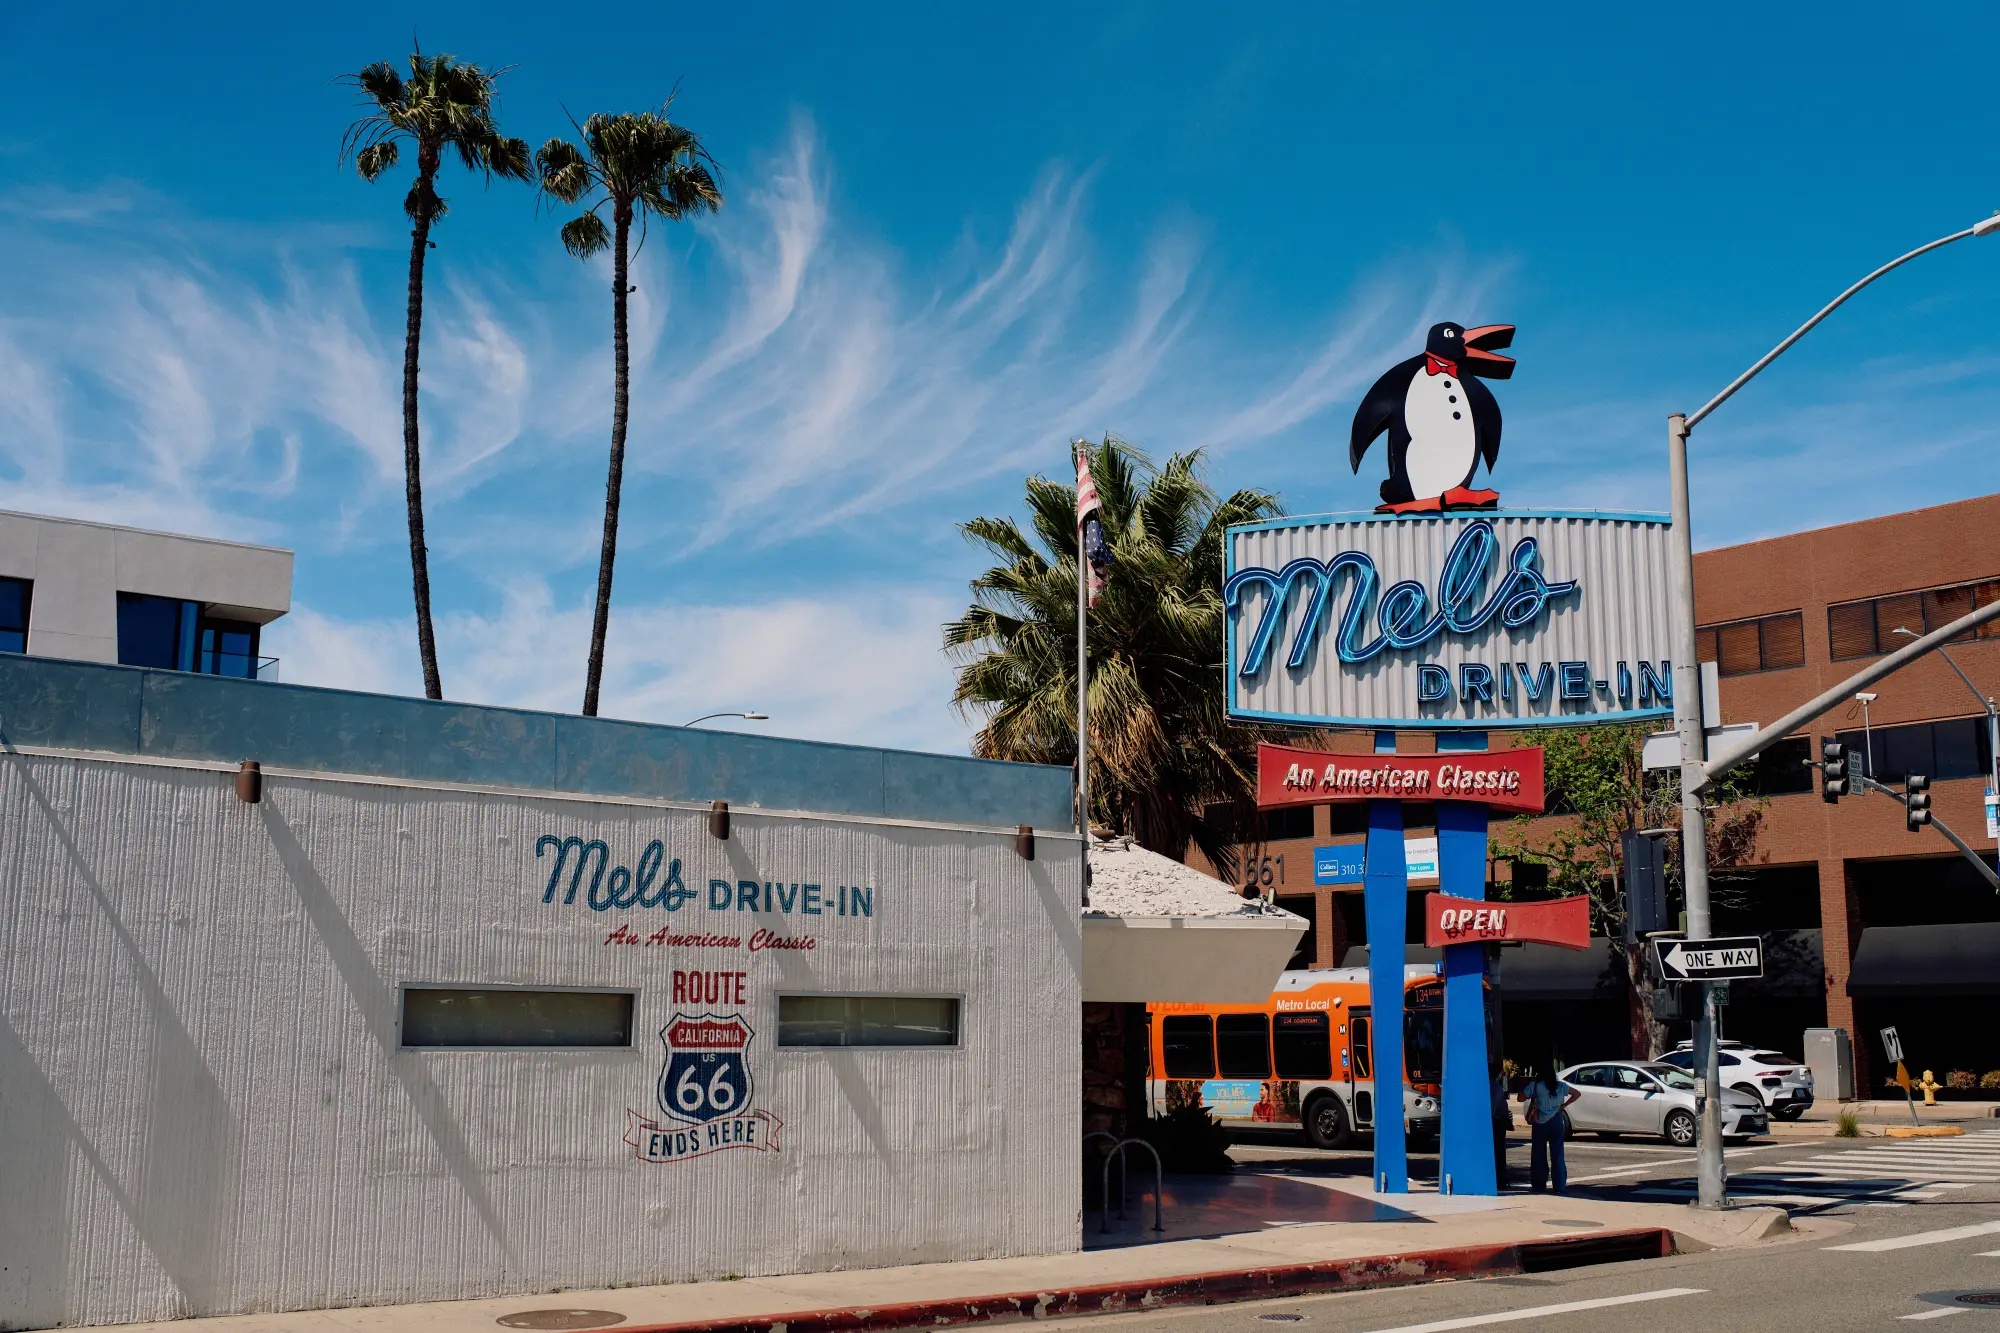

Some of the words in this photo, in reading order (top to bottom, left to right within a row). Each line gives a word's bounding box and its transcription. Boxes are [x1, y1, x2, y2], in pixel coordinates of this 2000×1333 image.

[1222, 520, 1578, 677] Mels
[1416, 660, 1672, 703] DRIVE-IN
[1282, 763, 1315, 786] An
[1319, 763, 1430, 788] American
[1436, 764, 1520, 789] Classic
[536, 834, 698, 911] Mels
[709, 879, 873, 917] DRIVE-IN
[1341, 864, 1356, 876] 310
[1440, 909, 1506, 930] OPEN
[604, 924, 640, 946] An
[645, 926, 742, 948] American
[748, 928, 816, 951] Classic
[1685, 952, 1716, 968] ONE
[1721, 950, 1754, 966] WAY
[672, 970, 747, 1005] ROUTE
[1276, 999, 1303, 1011] Metro
[1306, 998, 1330, 1010] Local
[677, 1027, 741, 1044] CALIFORNIA
[702, 1052, 716, 1063] US
[676, 1062, 735, 1112] 66
[648, 1129, 700, 1157] ENDS
[707, 1120, 757, 1147] HERE
